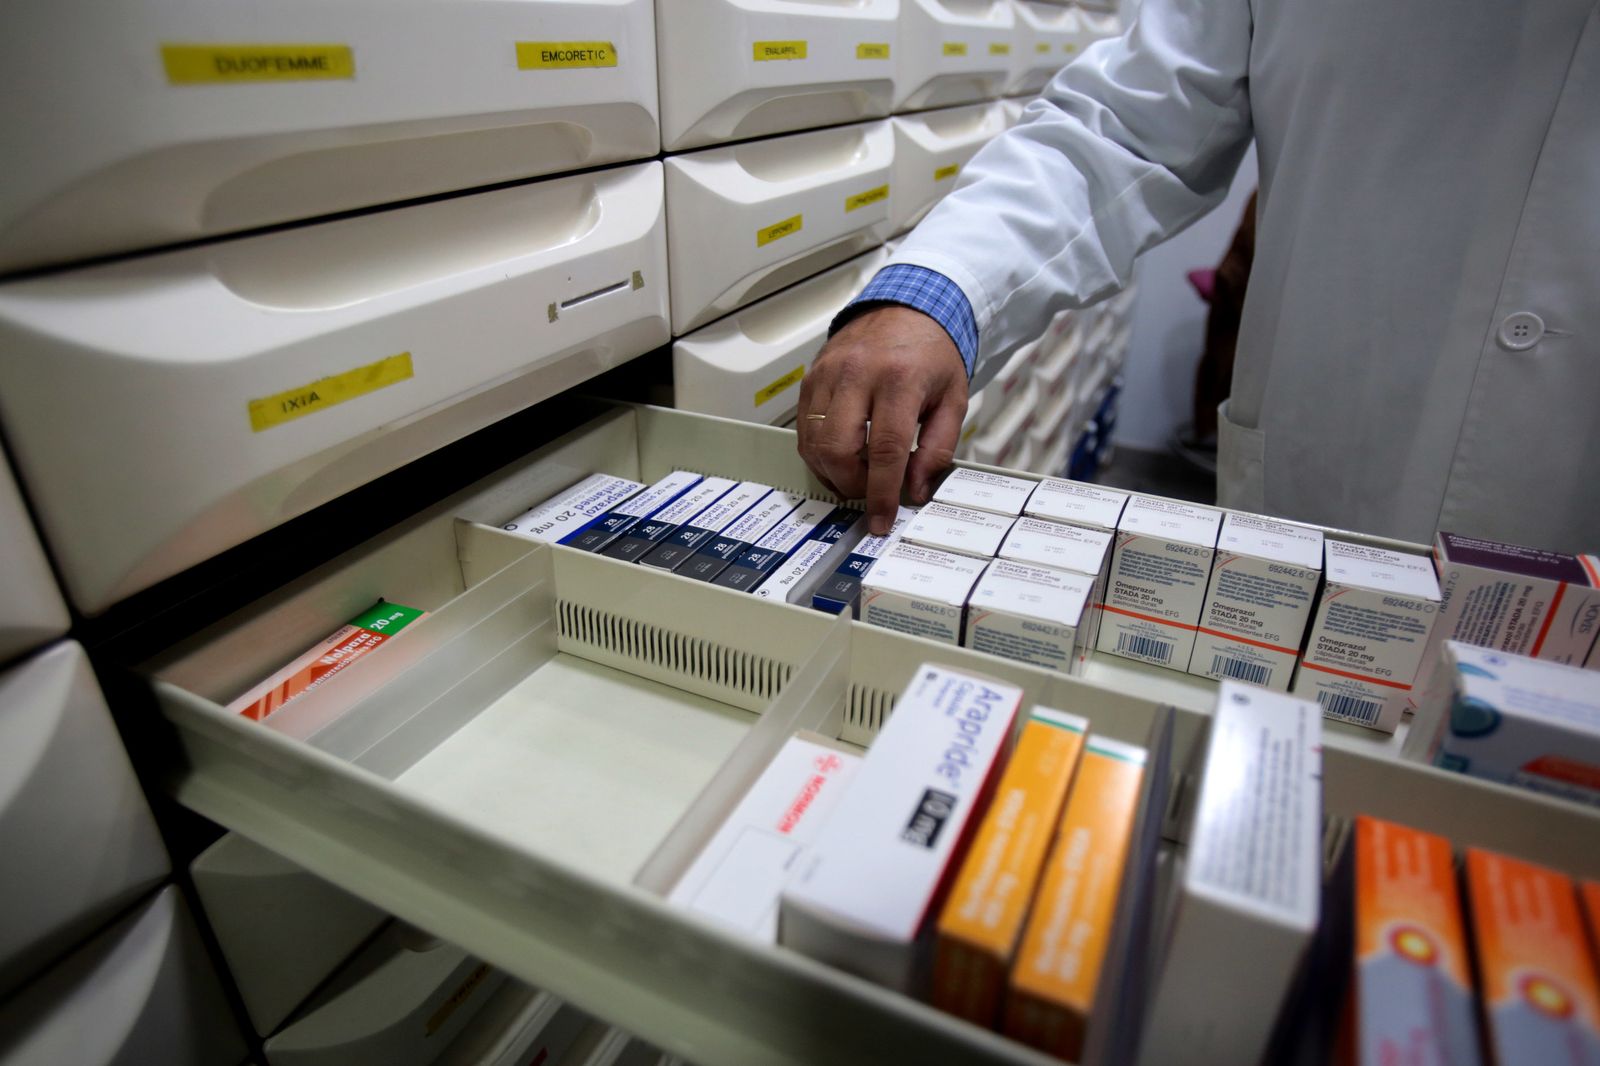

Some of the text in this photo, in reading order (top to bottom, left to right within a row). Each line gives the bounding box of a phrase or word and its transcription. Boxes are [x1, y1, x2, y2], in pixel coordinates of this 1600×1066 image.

[541, 49, 605, 62] EMCORETIC
[214, 55, 329, 74] DUOFEMME
[281, 391, 321, 413] IXIA
[530, 480, 625, 536] cinfamed 20 mg
[584, 483, 638, 518] omeprazol
[930, 506, 957, 516] STADA
[604, 518, 618, 527] 28
[642, 525, 656, 534] 28
[726, 513, 756, 537] omeprazol
[735, 514, 763, 539] cinfamed
[681, 531, 694, 540] 28
[760, 523, 787, 548] omeprazol
[769, 525, 795, 550] cinfamed
[714, 543, 728, 552] 28
[895, 546, 926, 557] STADA
[1165, 543, 1199, 557] 692442.6
[1331, 545, 1366, 556] STADA
[748, 553, 761, 562] 28
[849, 560, 862, 570] 28
[792, 566, 805, 576] 20
[996, 564, 1029, 576] STADA
[1268, 564, 1305, 578] 692442.6
[779, 575, 794, 585] mg
[1115, 580, 1156, 595] Omeprazol
[1113, 587, 1139, 598] STADA
[1151, 597, 1164, 605] mg
[910, 601, 946, 616] 692442.6
[1212, 601, 1256, 617] Omeprazol
[1383, 596, 1422, 612] 692442.6
[1508, 605, 1523, 628] STADA
[1518, 594, 1528, 605] 20
[1523, 585, 1534, 597] mg
[1533, 600, 1545, 615] EFG
[370, 610, 404, 631] 20 mg
[1164, 609, 1180, 618] EFG
[1210, 608, 1264, 627] STADA 20 mg
[1579, 603, 1600, 634] STADA
[365, 635, 383, 650] EFG
[1264, 633, 1280, 642] EFG
[1319, 636, 1366, 652] Omeprazol
[319, 632, 372, 666] Nolpaza
[1317, 643, 1346, 656] STADA
[1361, 654, 1376, 662] mg
[1375, 667, 1392, 677] EFG
[936, 686, 1003, 780] Arapride
[777, 774, 826, 834] NORMON
[901, 789, 957, 846] 10 mg
